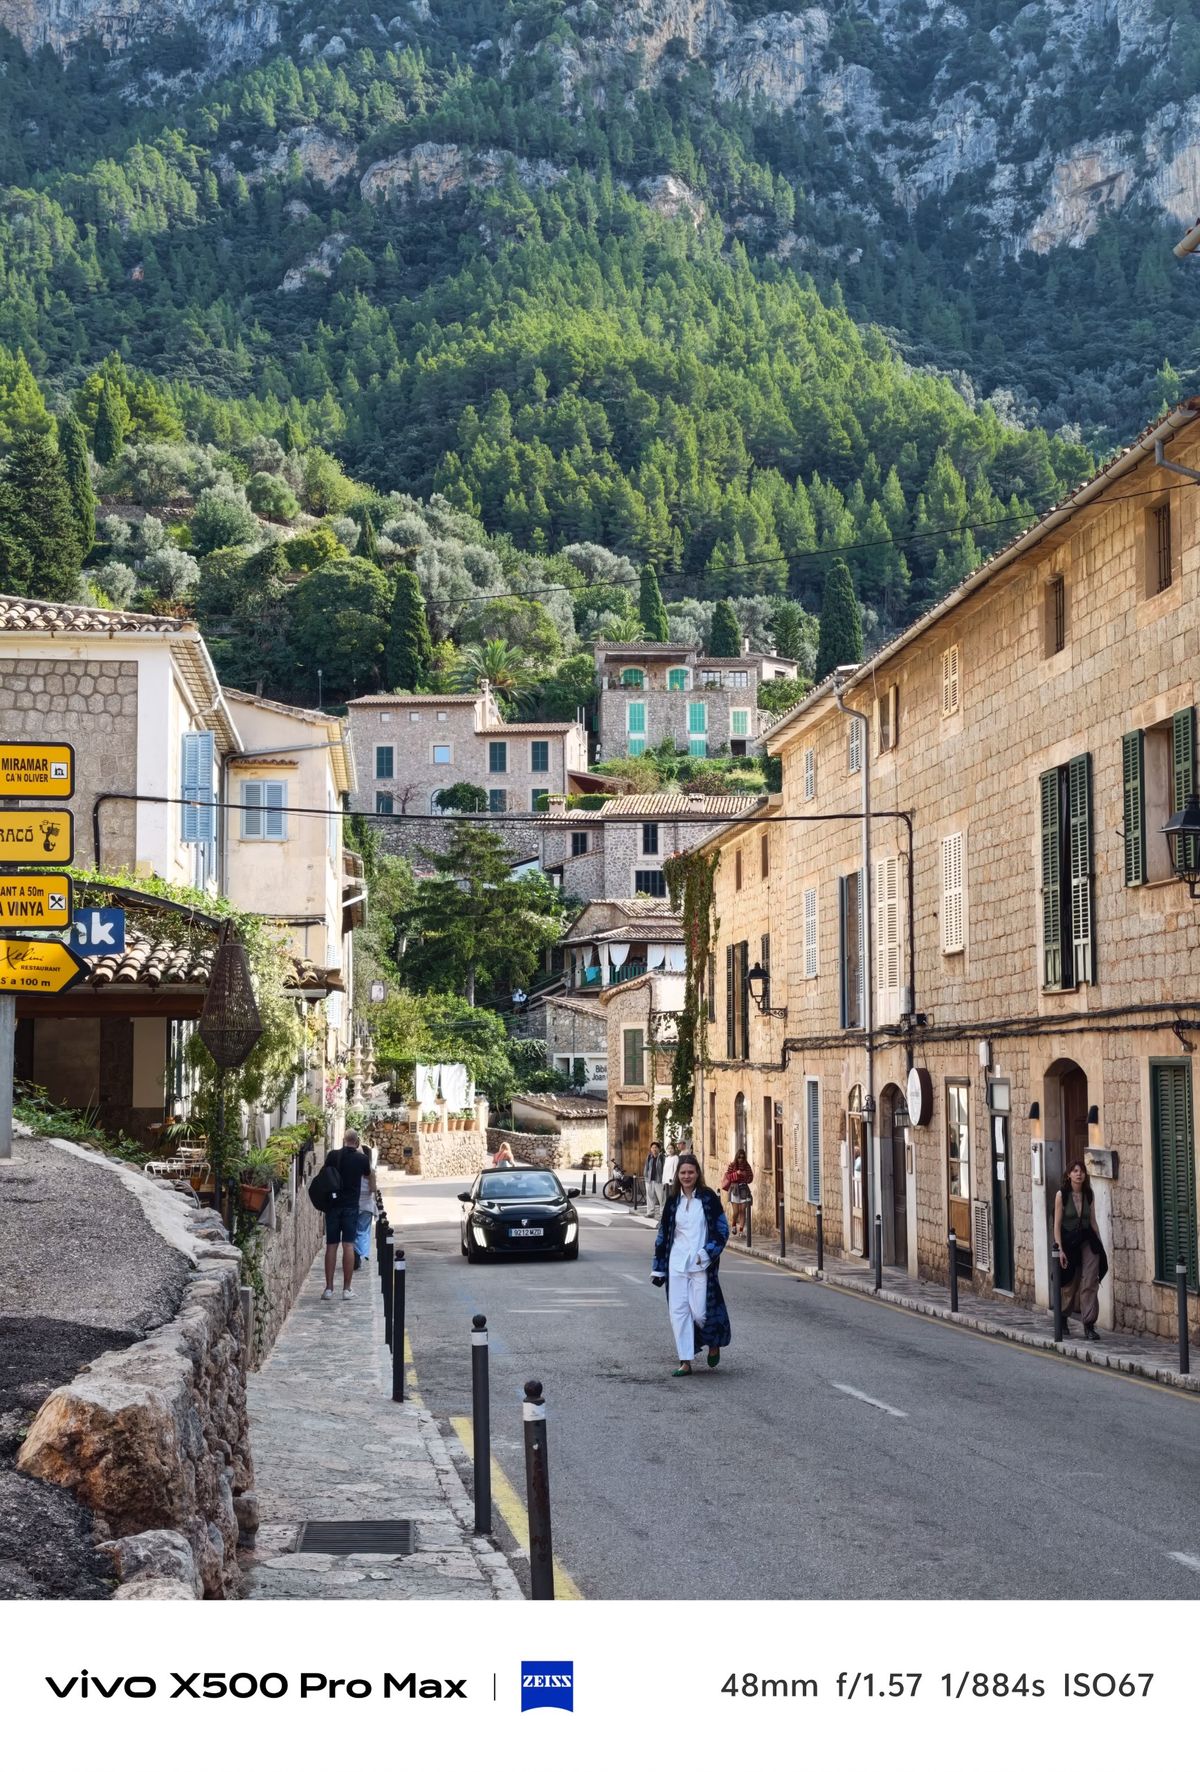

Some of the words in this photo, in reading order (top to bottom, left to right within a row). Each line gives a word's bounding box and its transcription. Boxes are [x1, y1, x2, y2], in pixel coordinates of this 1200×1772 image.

[2, 758, 49, 771] MIRAMAR
[24, 774, 49, 782] OLIVER
[19, 886, 25, 896] A
[27, 886, 45, 896] 50m
[7, 901, 44, 916] VINYA
[21, 978, 38, 986] 100
